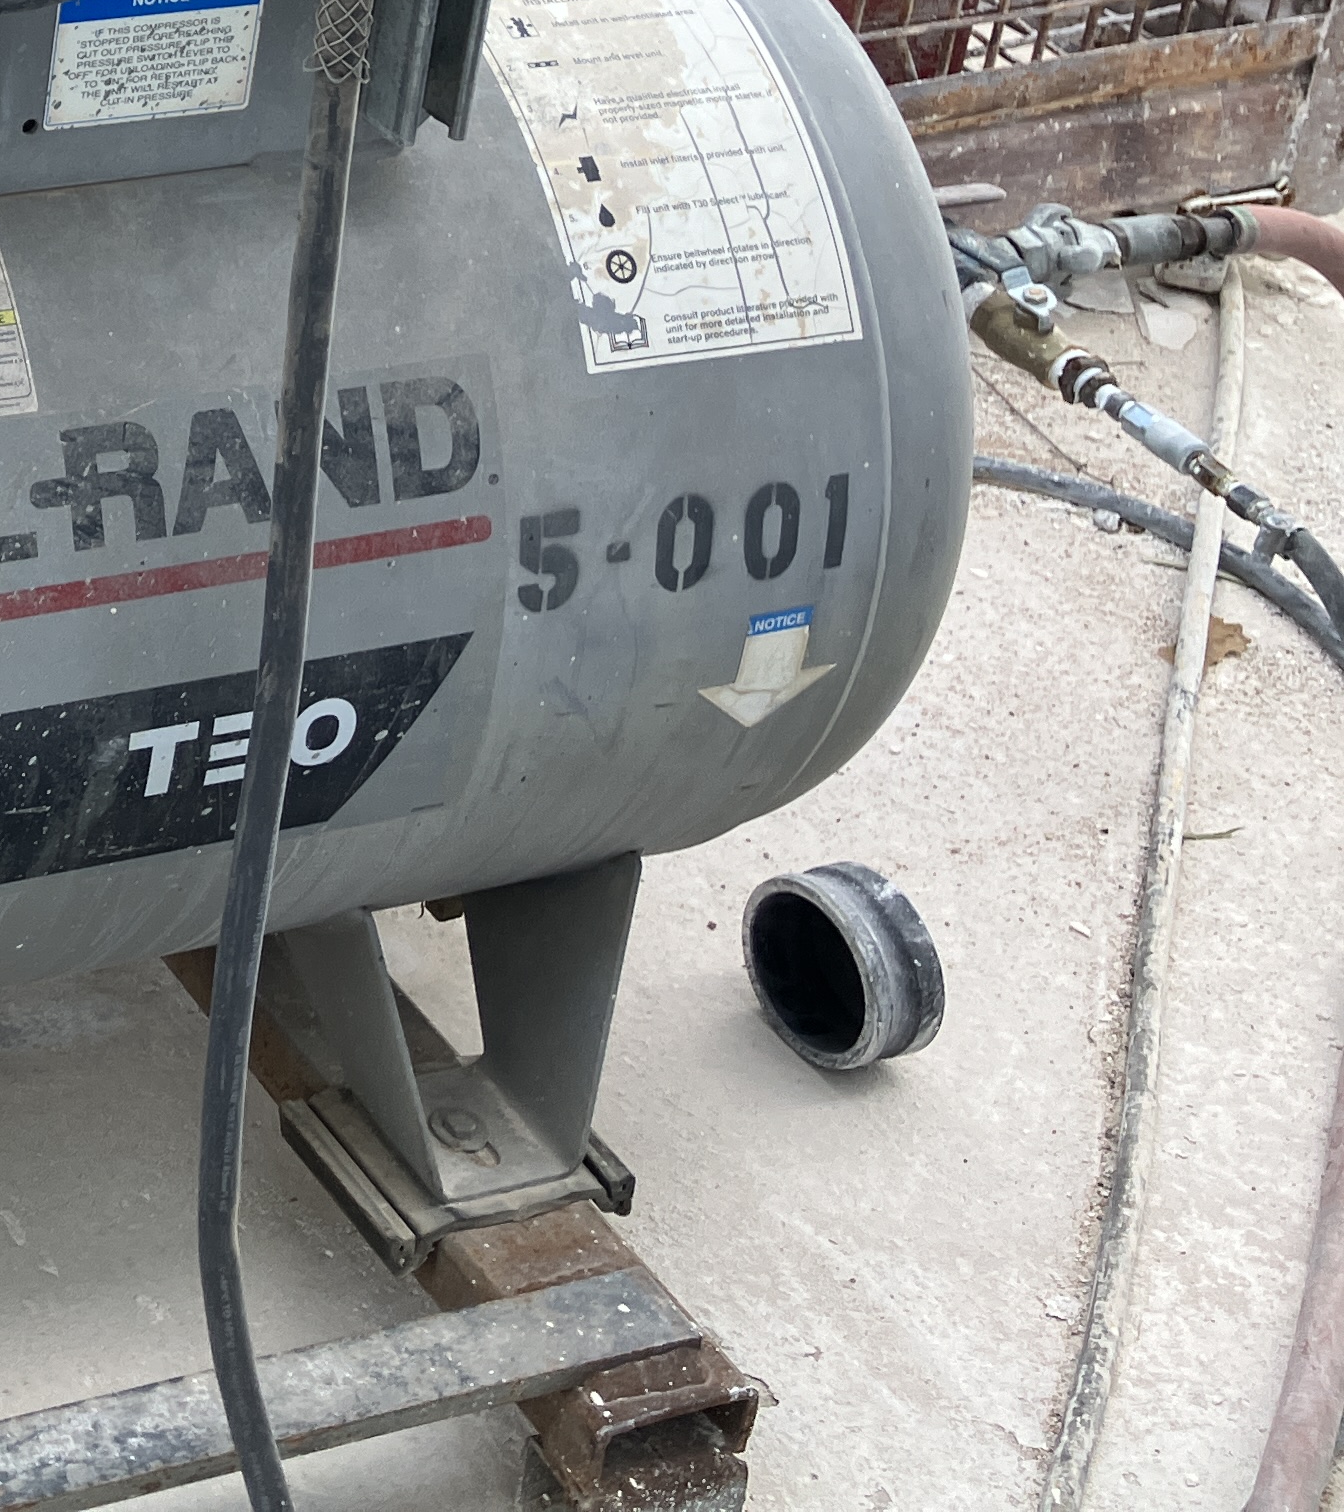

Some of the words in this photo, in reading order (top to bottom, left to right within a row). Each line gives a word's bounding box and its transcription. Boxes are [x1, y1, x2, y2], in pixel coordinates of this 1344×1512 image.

[107, 26, 131, 36] THIS
[133, 18, 208, 34] COMPRESSOR
[210, 16, 221, 26] IS
[132, 31, 177, 44] BEFORE
[178, 26, 233, 38] REACHING
[77, 49, 99, 60] CUT
[101, 47, 123, 58] OUT
[77, 56, 134, 70] PRESSURE
[137, 51, 178, 61] SWITCH
[179, 47, 214, 59] LEVER
[216, 45, 232, 55] TO
[572, 55, 602, 66] Mount
[95, 66, 118, 78] FOR
[186, 58, 210, 68] FLIP
[211, 55, 240, 66] BACK
[84, 79, 98, 89] TO
[125, 73, 148, 84] FOR
[81, 89, 102, 100] THE
[130, 83, 155, 94] WILL
[625, 90, 664, 104] qualified
[666, 85, 712, 100] electrician
[99, 95, 135, 108] CUT-IN
[602, 115, 619, 125] not
[620, 156, 649, 169] Install
[706, 147, 744, 162] provided
[653, 202, 671, 214] unit
[692, 198, 709, 209] T30
[683, 245, 726, 259] beltwheel
[653, 260, 695, 275] indicated
[696, 259, 708, 271] by
[663, 311, 700, 324] Consult
[700, 306, 736, 321] product
[819, 292, 839, 303] with
[665, 324, 684, 335] unit
[684, 322, 699, 332] for
[699, 320, 724, 330] more
[812, 304, 831, 316] and
[667, 333, 704, 346] start-up
[516, 473, 850, 613] 5-001
[754, 611, 807, 633] NOTICE
